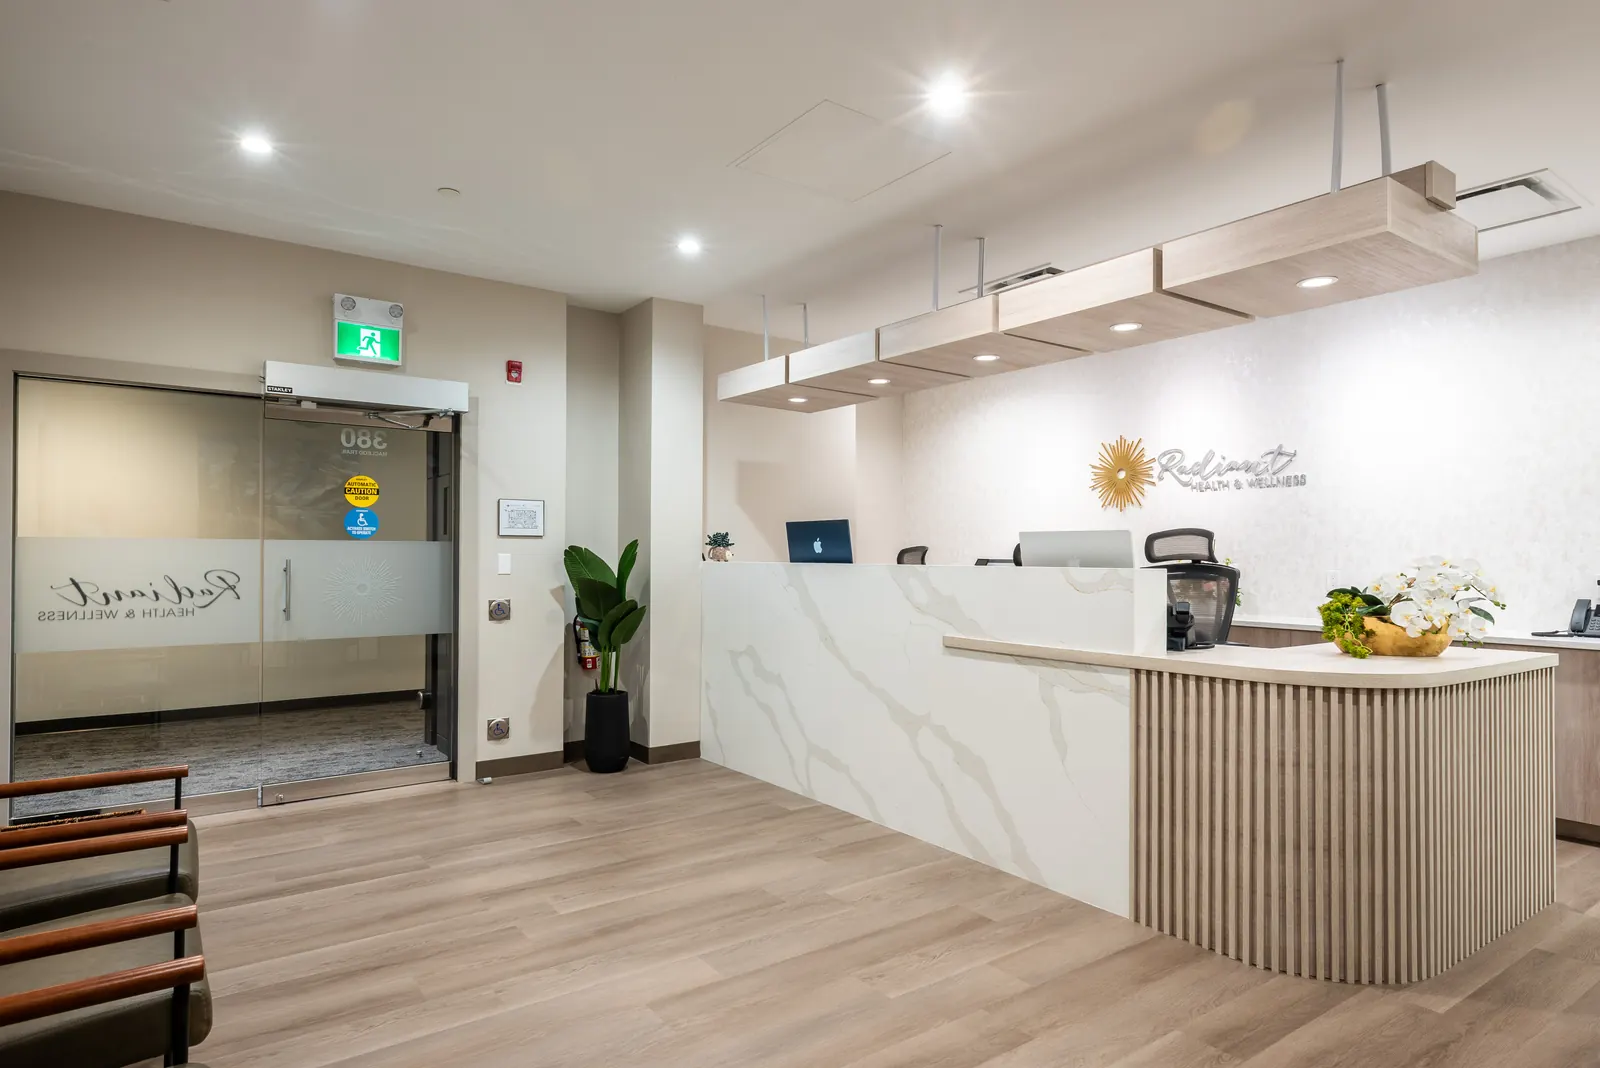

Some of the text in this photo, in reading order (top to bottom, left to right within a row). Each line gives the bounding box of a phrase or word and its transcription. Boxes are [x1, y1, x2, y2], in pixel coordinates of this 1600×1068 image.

[1157, 444, 1297, 488] Radiant
[1190, 474, 1307, 492] HEALTH & WELLNESS
